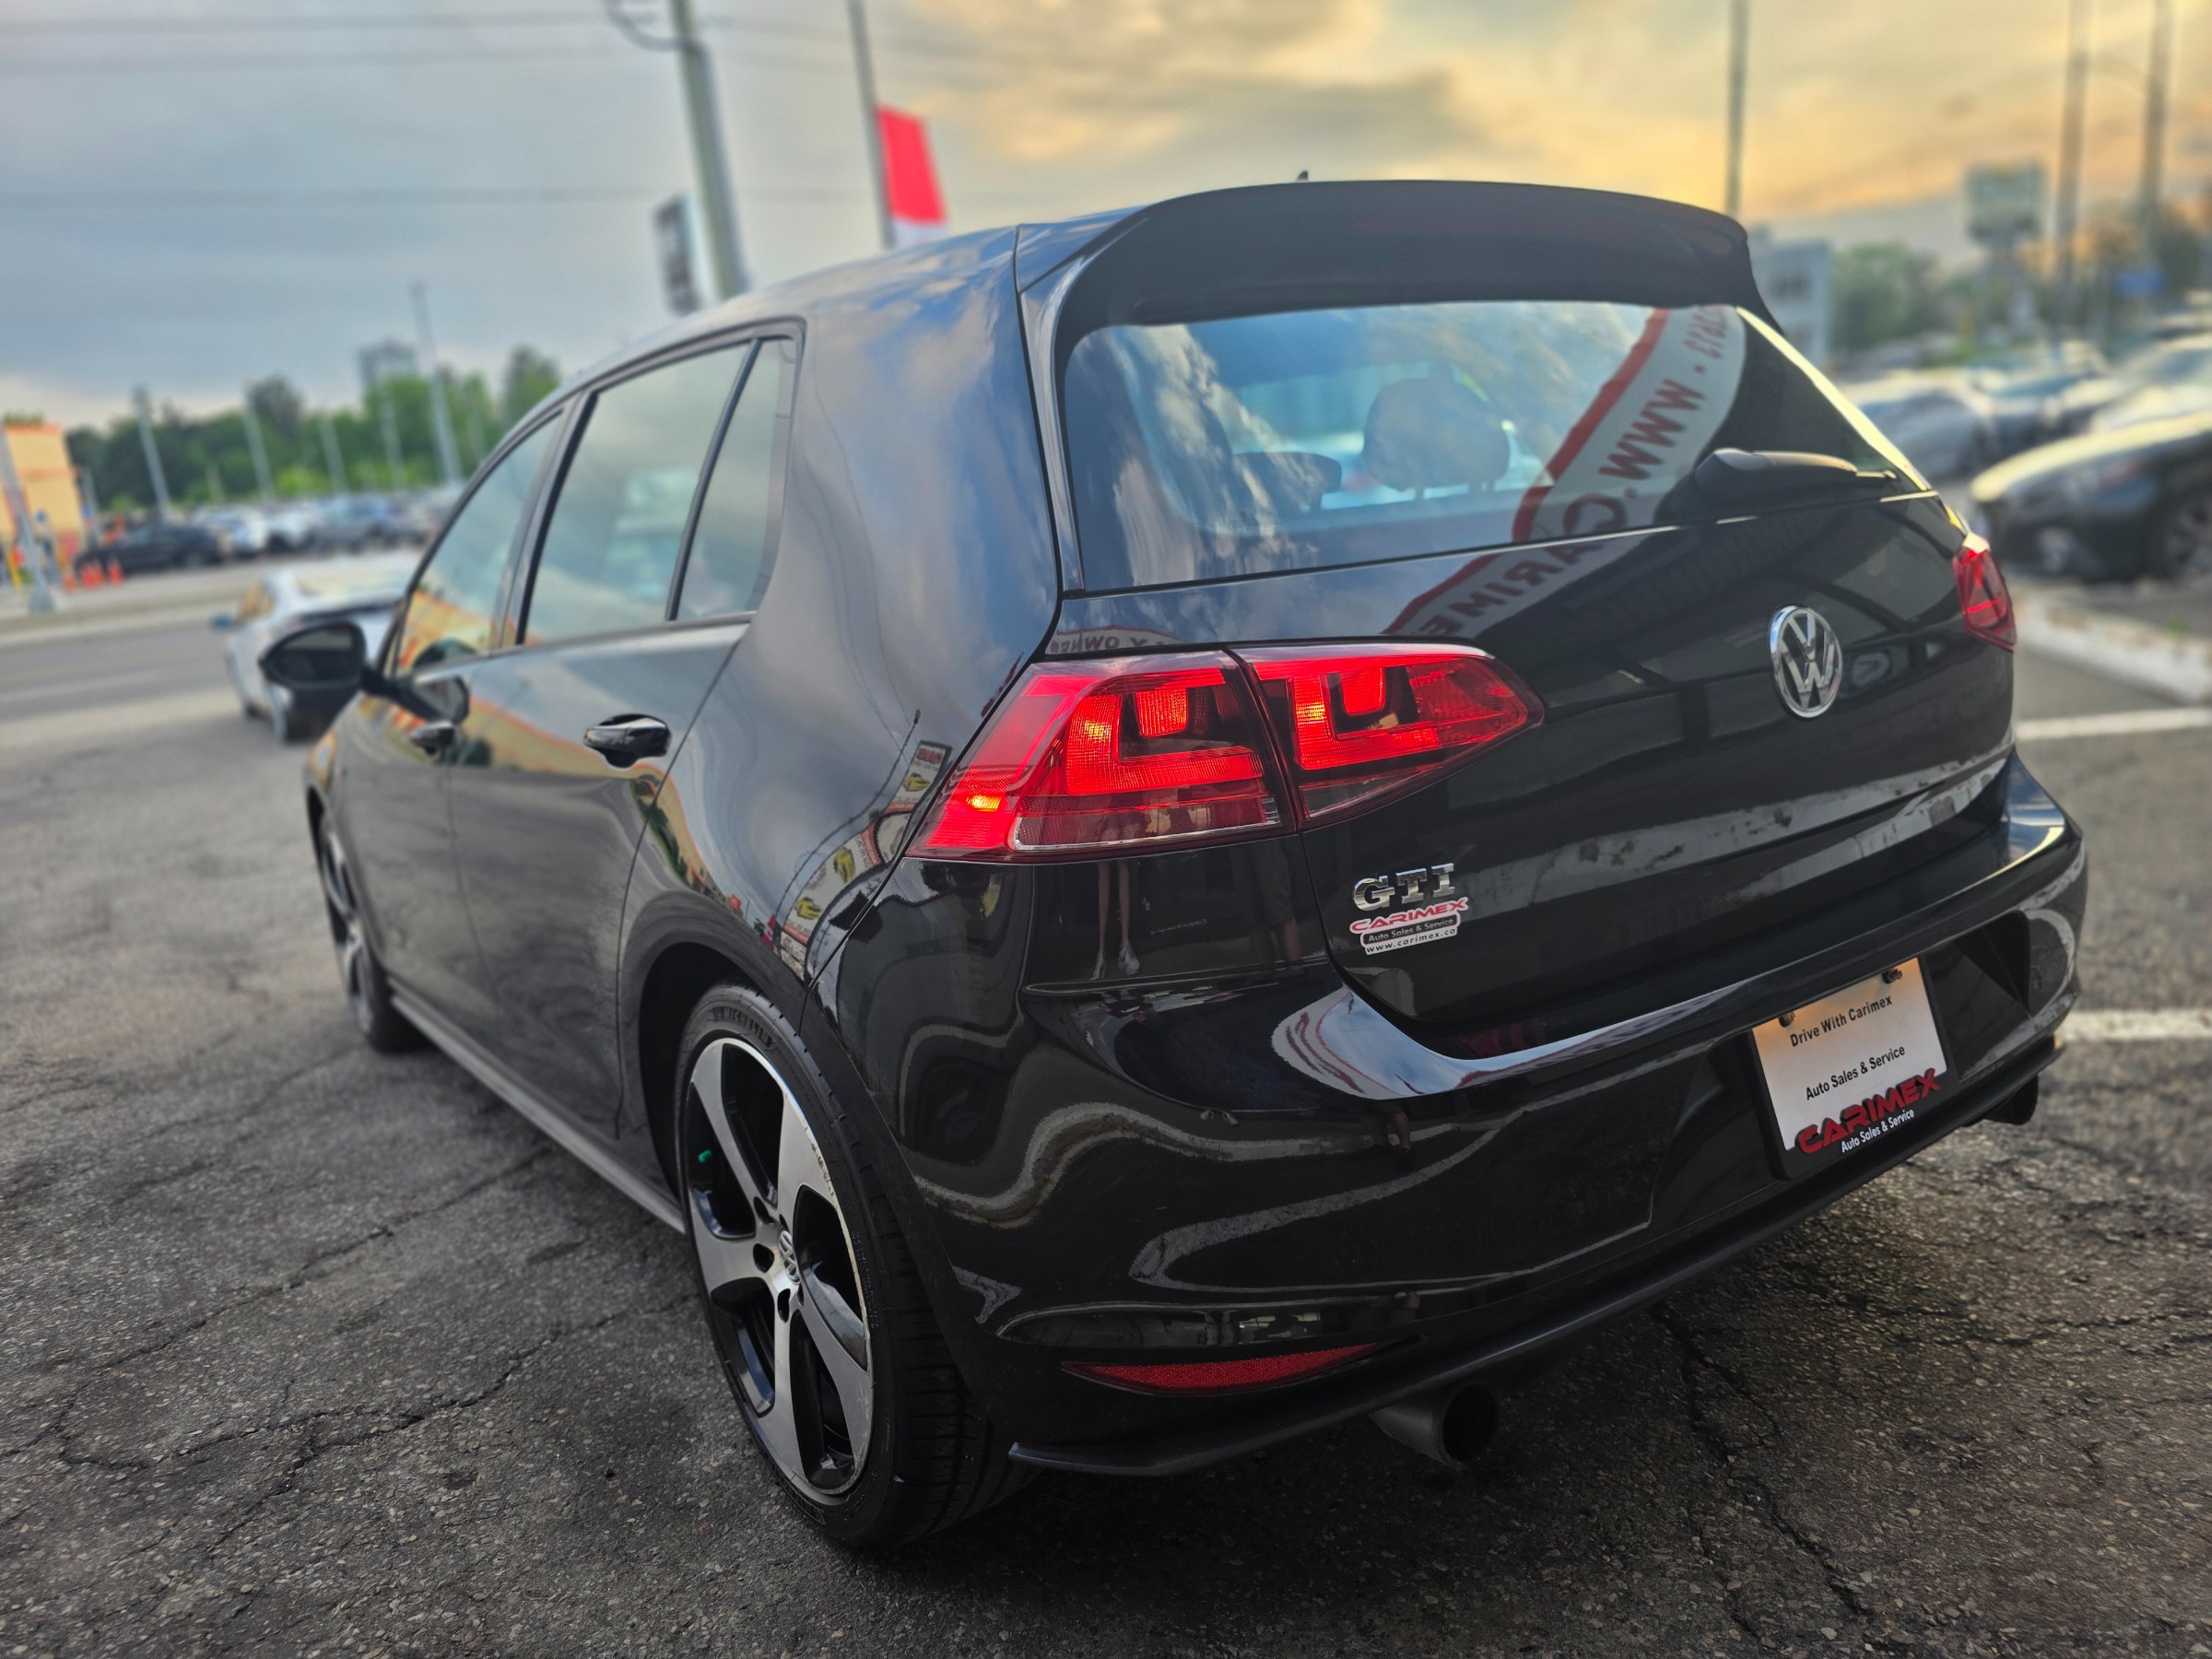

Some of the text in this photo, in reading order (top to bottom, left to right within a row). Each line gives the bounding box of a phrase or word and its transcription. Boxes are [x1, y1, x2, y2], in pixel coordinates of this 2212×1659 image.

[1353, 863, 1455, 912] GTI
[1351, 898, 1465, 931] CARIMEX
[1368, 916, 1453, 944] Auto Sales & Service
[1790, 994, 1893, 1047] Drive With Carimex
[1806, 1045, 1906, 1100] Auto Sales & Service
[1796, 1068, 1940, 1153] CARIMEX
[1841, 1107, 1915, 1153] Auto Sales & Service
